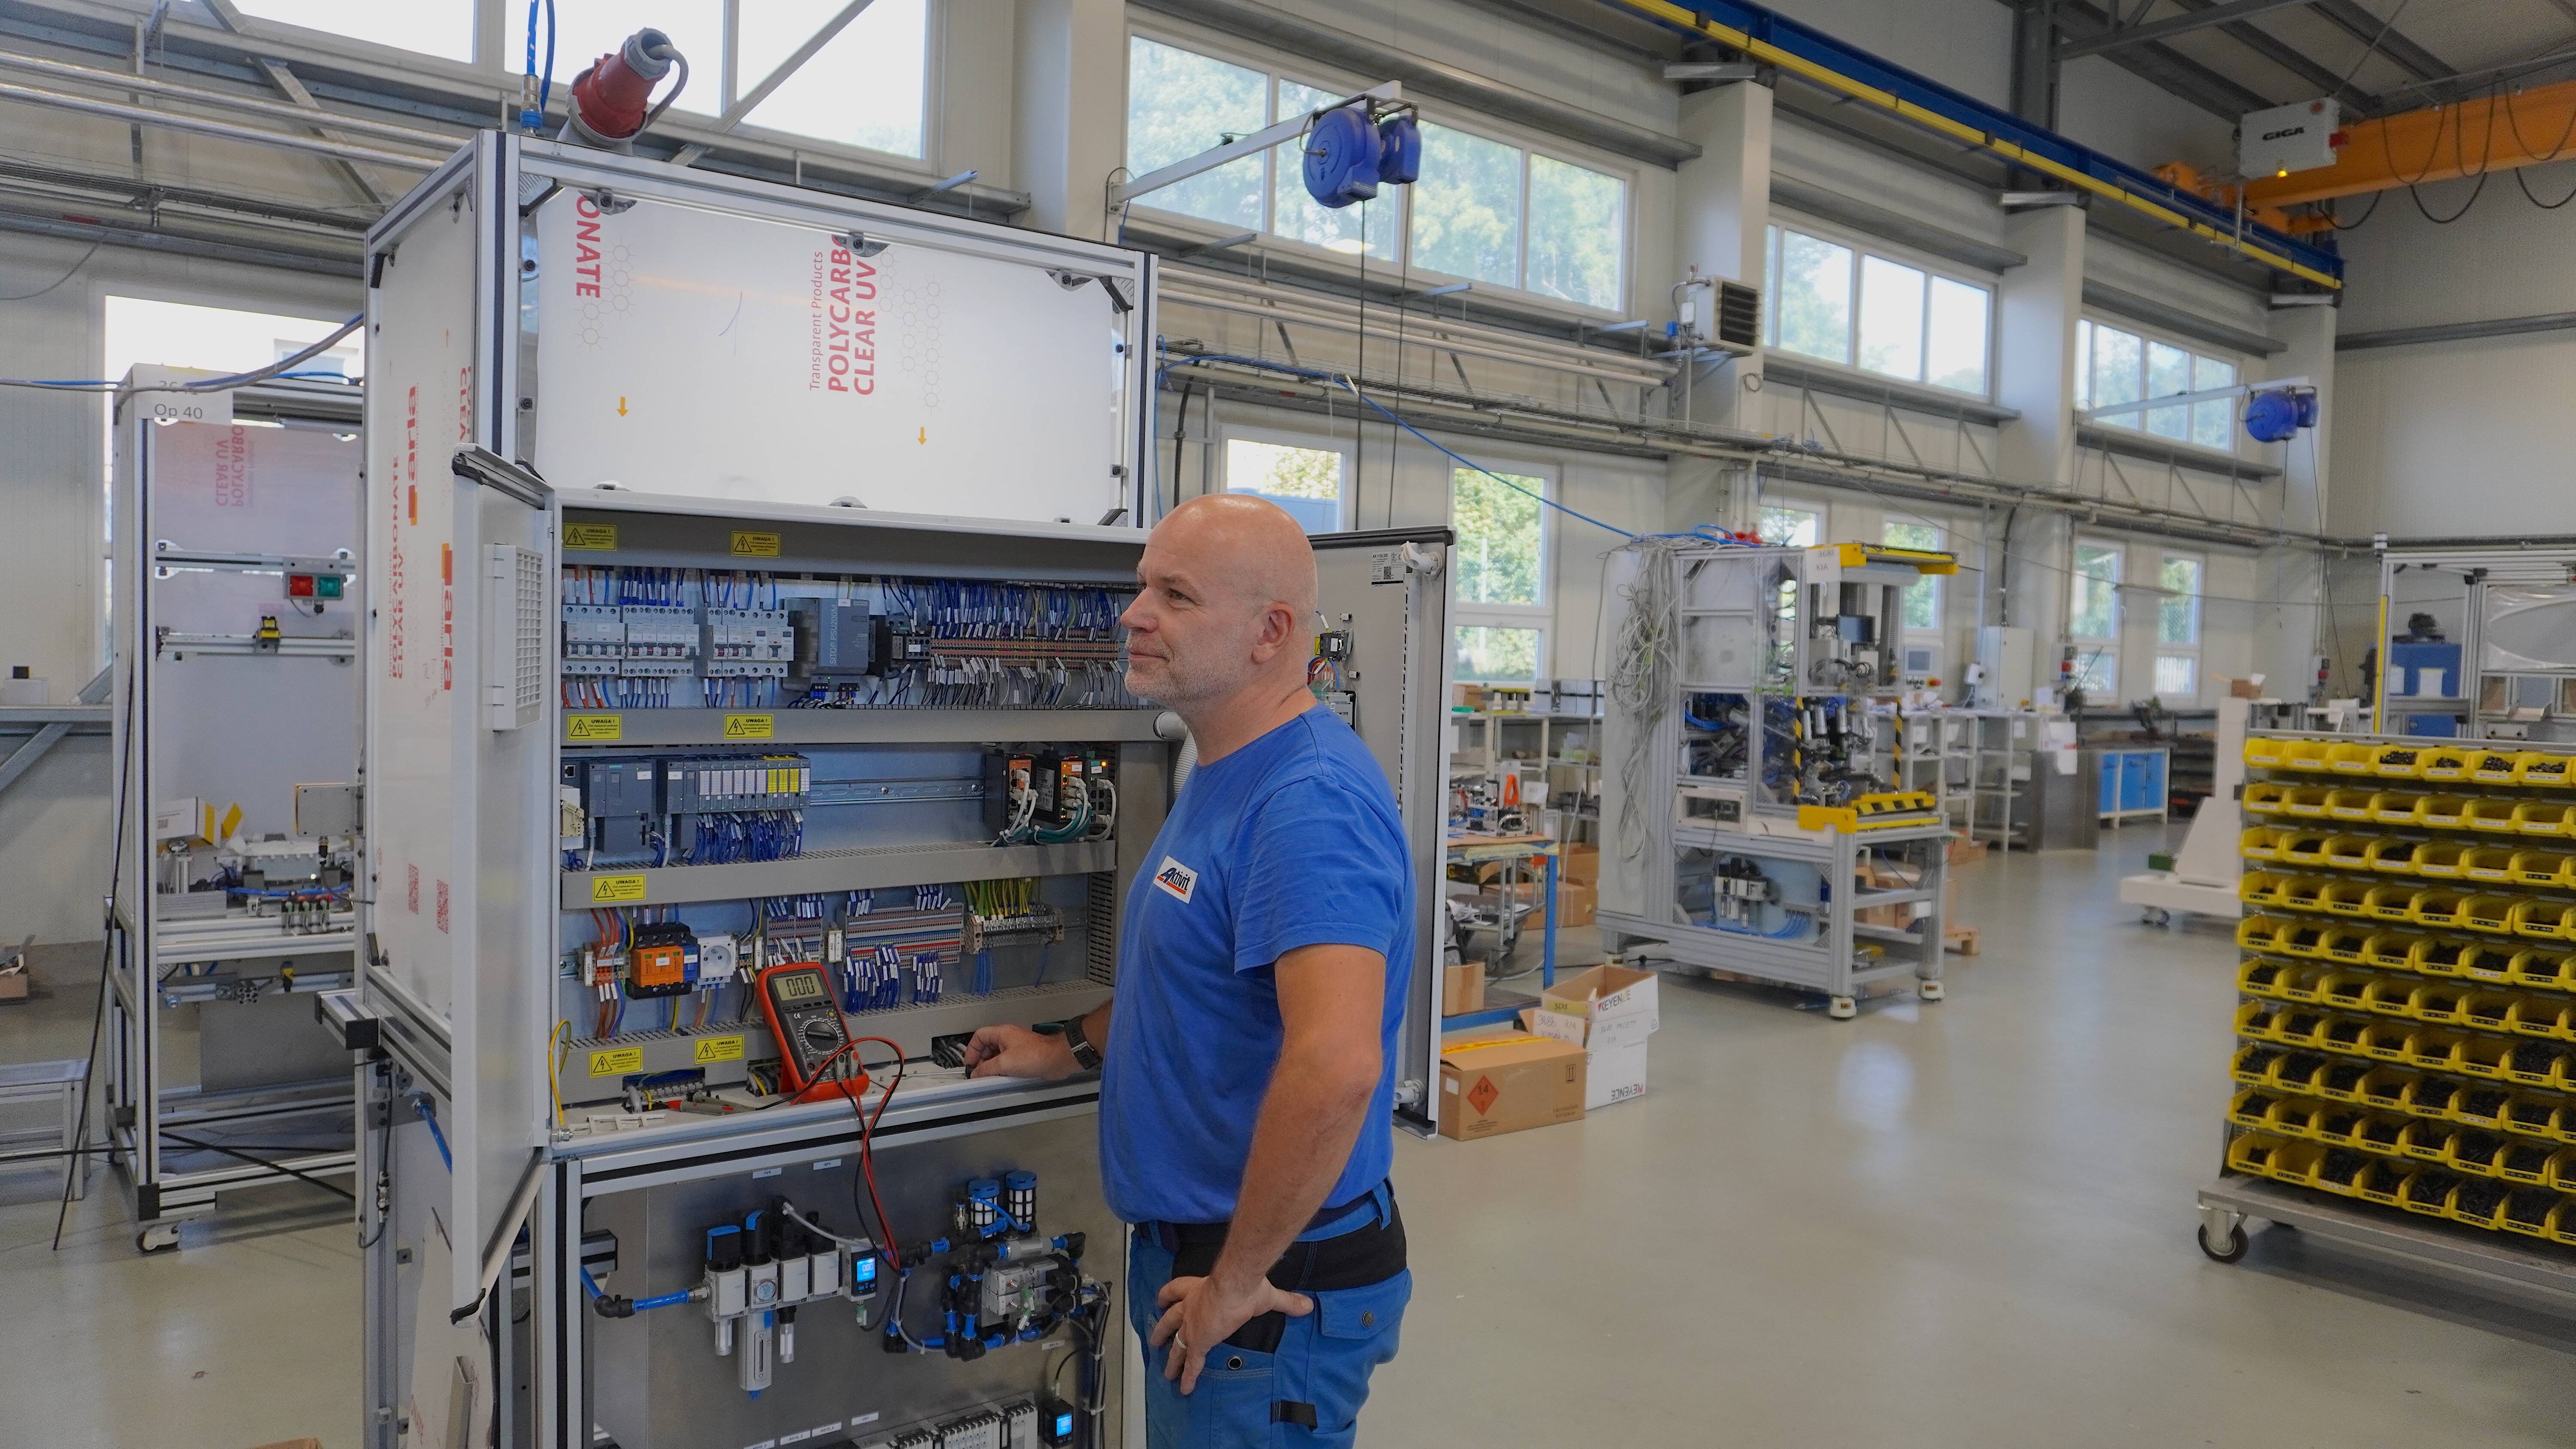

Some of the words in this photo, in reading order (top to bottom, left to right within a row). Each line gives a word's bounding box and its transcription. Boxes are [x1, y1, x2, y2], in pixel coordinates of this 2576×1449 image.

[2263, 127, 2305, 140] GIGA
[811, 252, 823, 309] Products
[856, 260, 876, 300] UV
[810, 313, 823, 390] Transparent
[854, 310, 875, 395] CLEAR
[154, 404, 177, 416] Op
[183, 406, 202, 419] 40
[398, 552, 403, 588] UV
[1598, 989, 1631, 1012] KEYENE
[1611, 1084, 1643, 1100] KEYENCE
